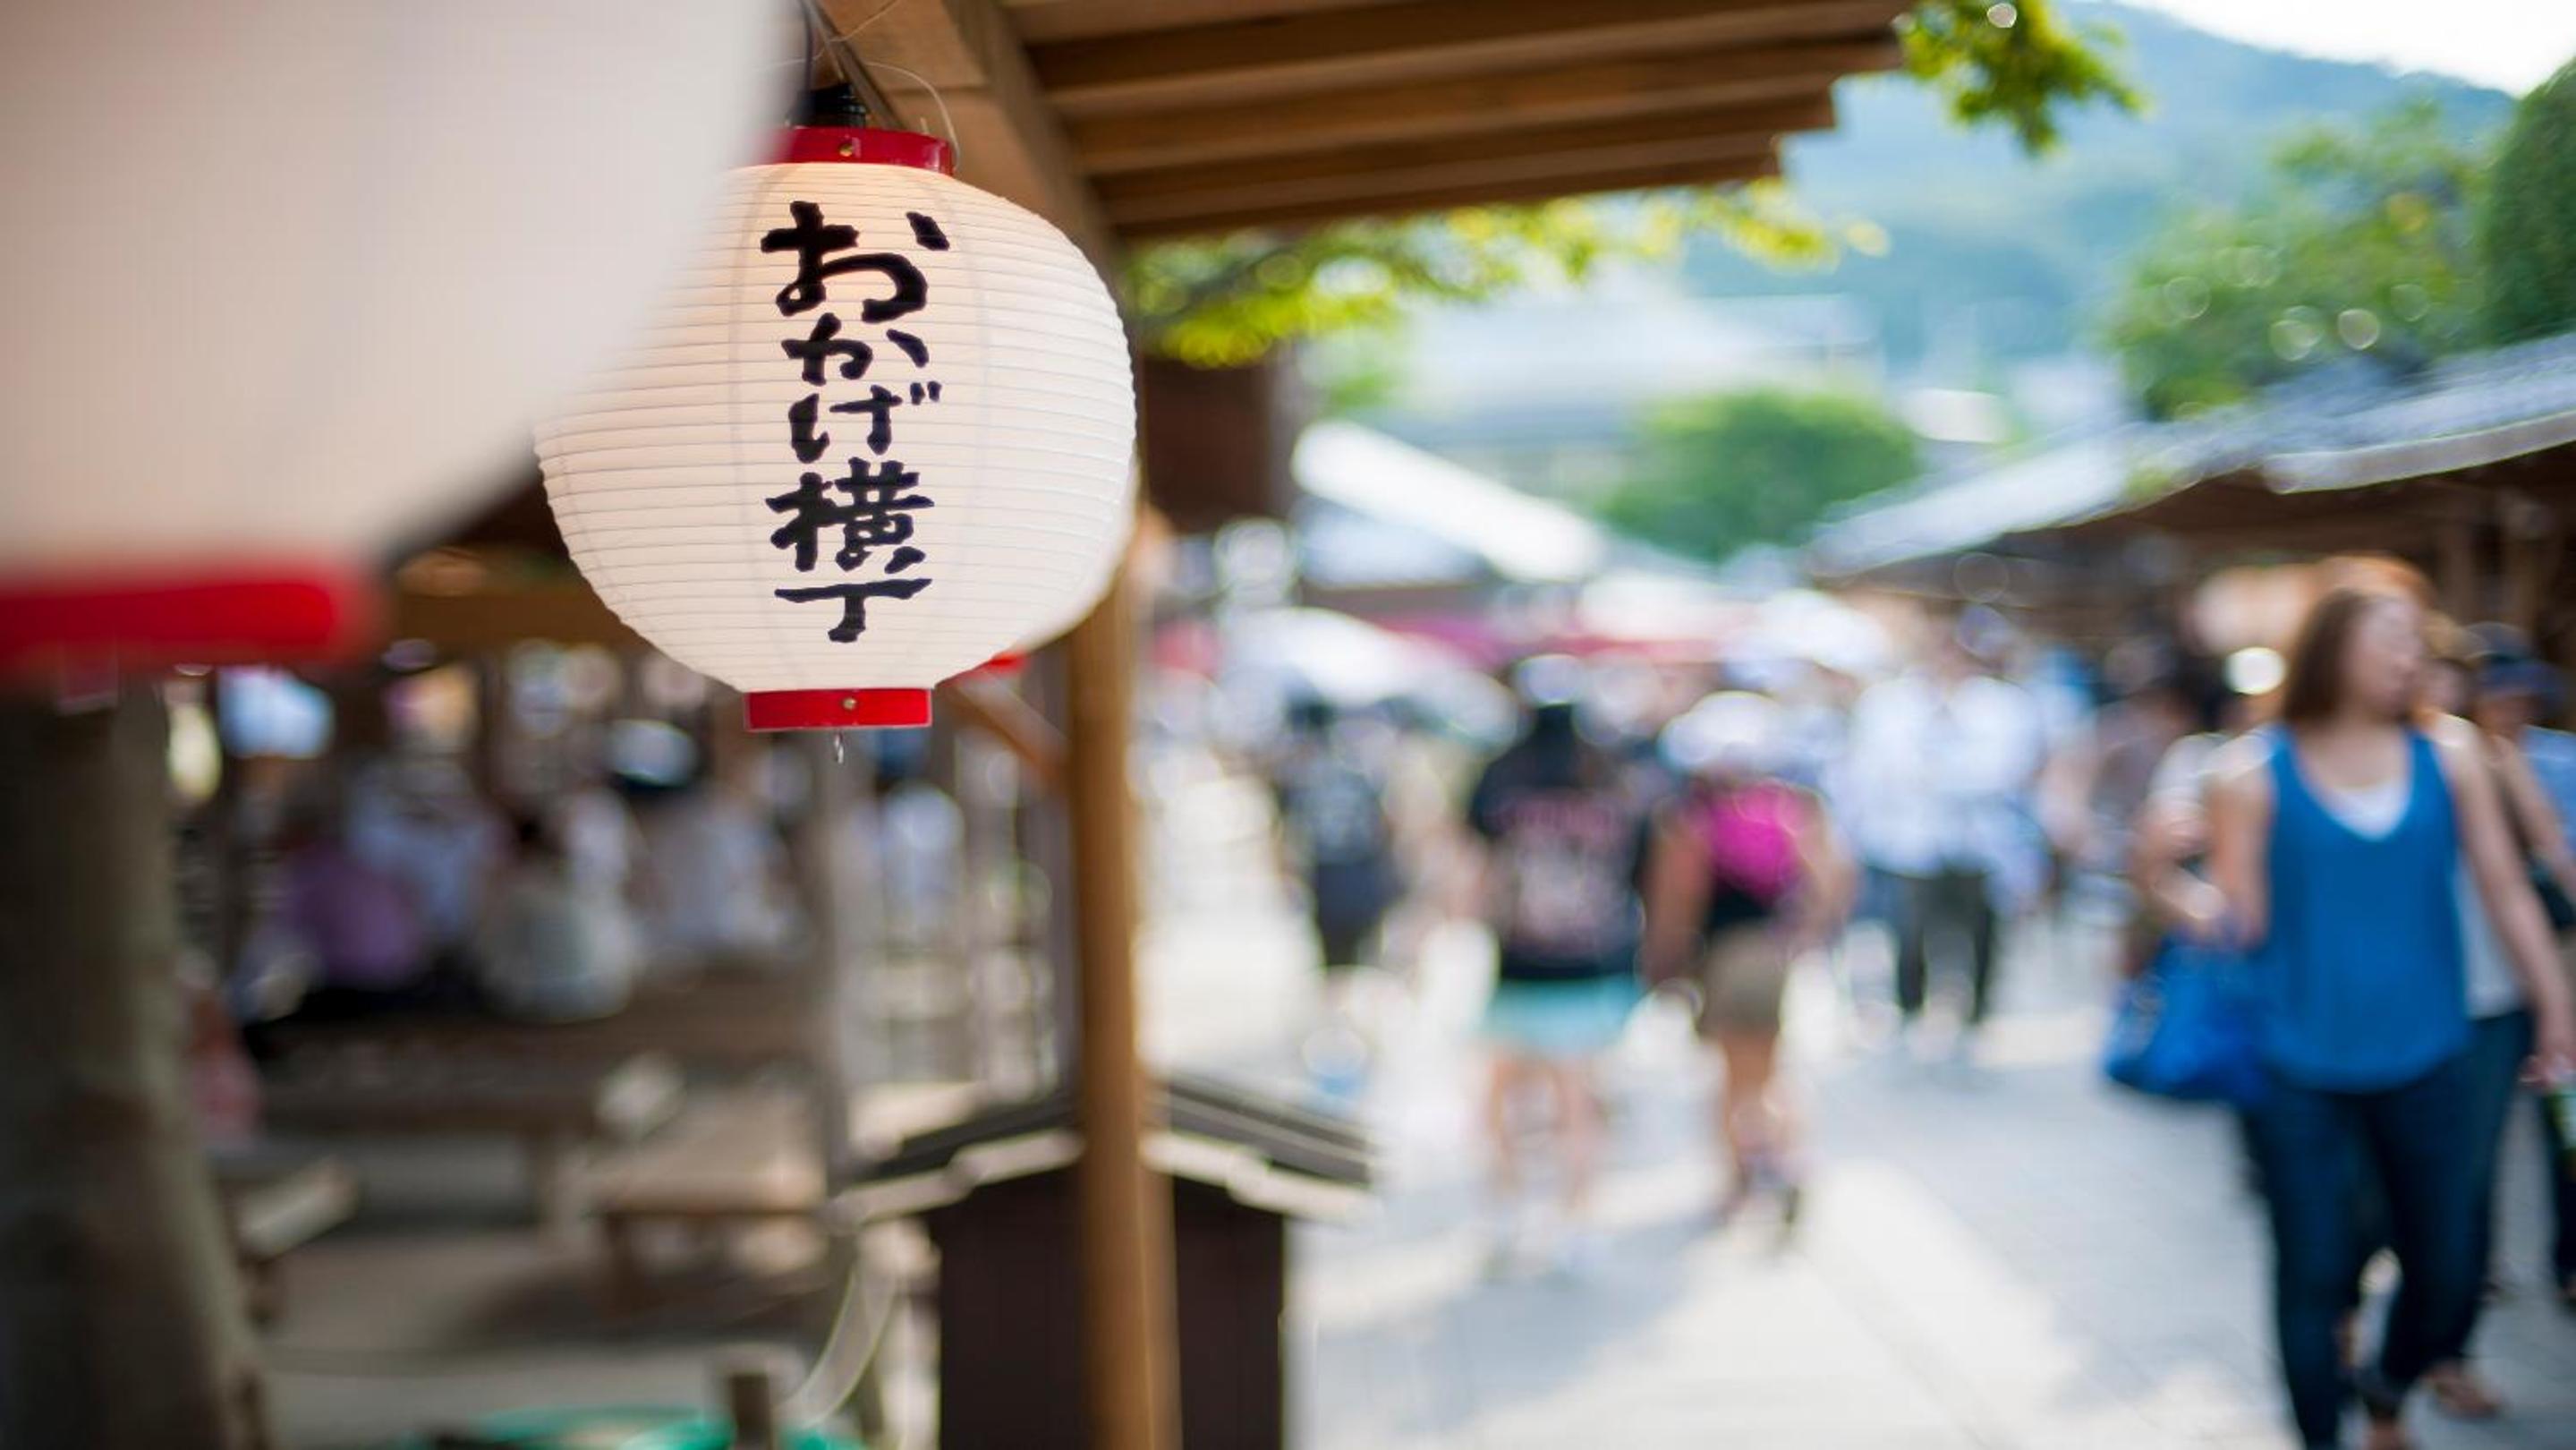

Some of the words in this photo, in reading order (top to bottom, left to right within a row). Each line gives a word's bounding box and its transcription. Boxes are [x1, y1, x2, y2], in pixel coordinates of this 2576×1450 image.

[761, 200, 950, 644] おかげ横丁
